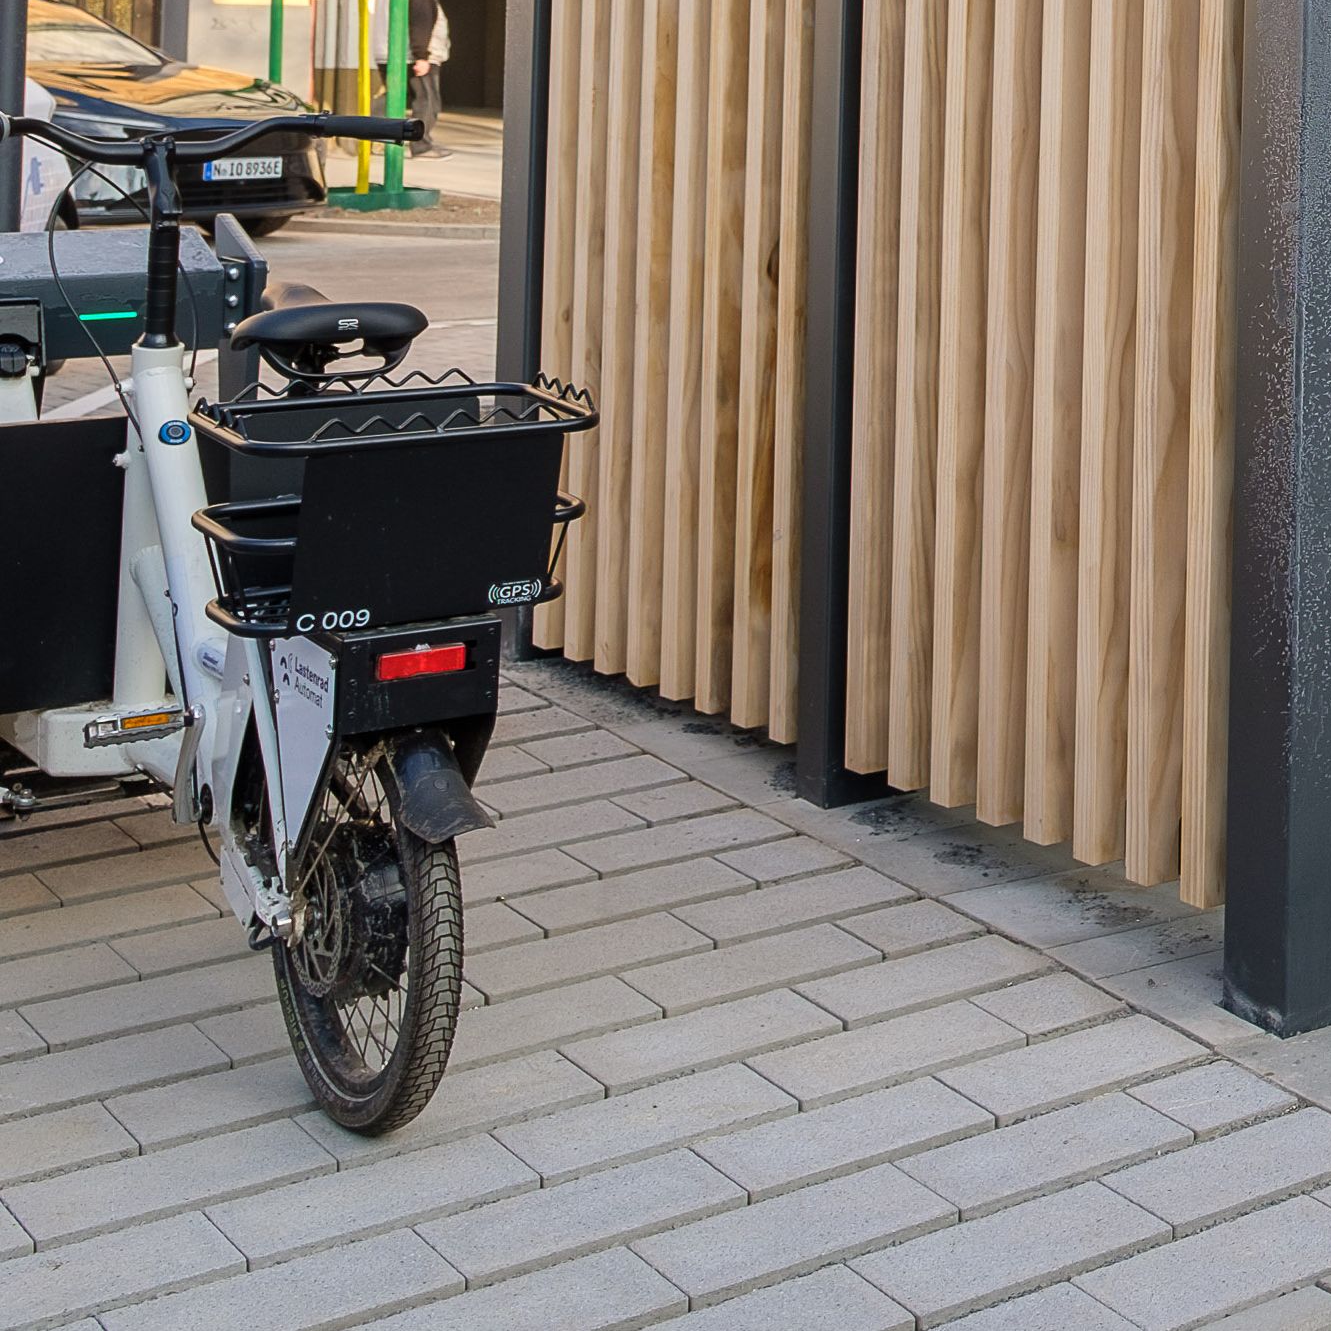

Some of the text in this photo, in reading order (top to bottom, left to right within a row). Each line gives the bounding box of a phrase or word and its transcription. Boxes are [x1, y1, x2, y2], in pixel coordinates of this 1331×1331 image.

[213, 164, 221, 176] N
[500, 583, 531, 598] GPS
[497, 596, 532, 605] TRACKING
[296, 609, 370, 632] C 009
[295, 656, 329, 693] Lastenrad
[294, 676, 323, 709] Automat
